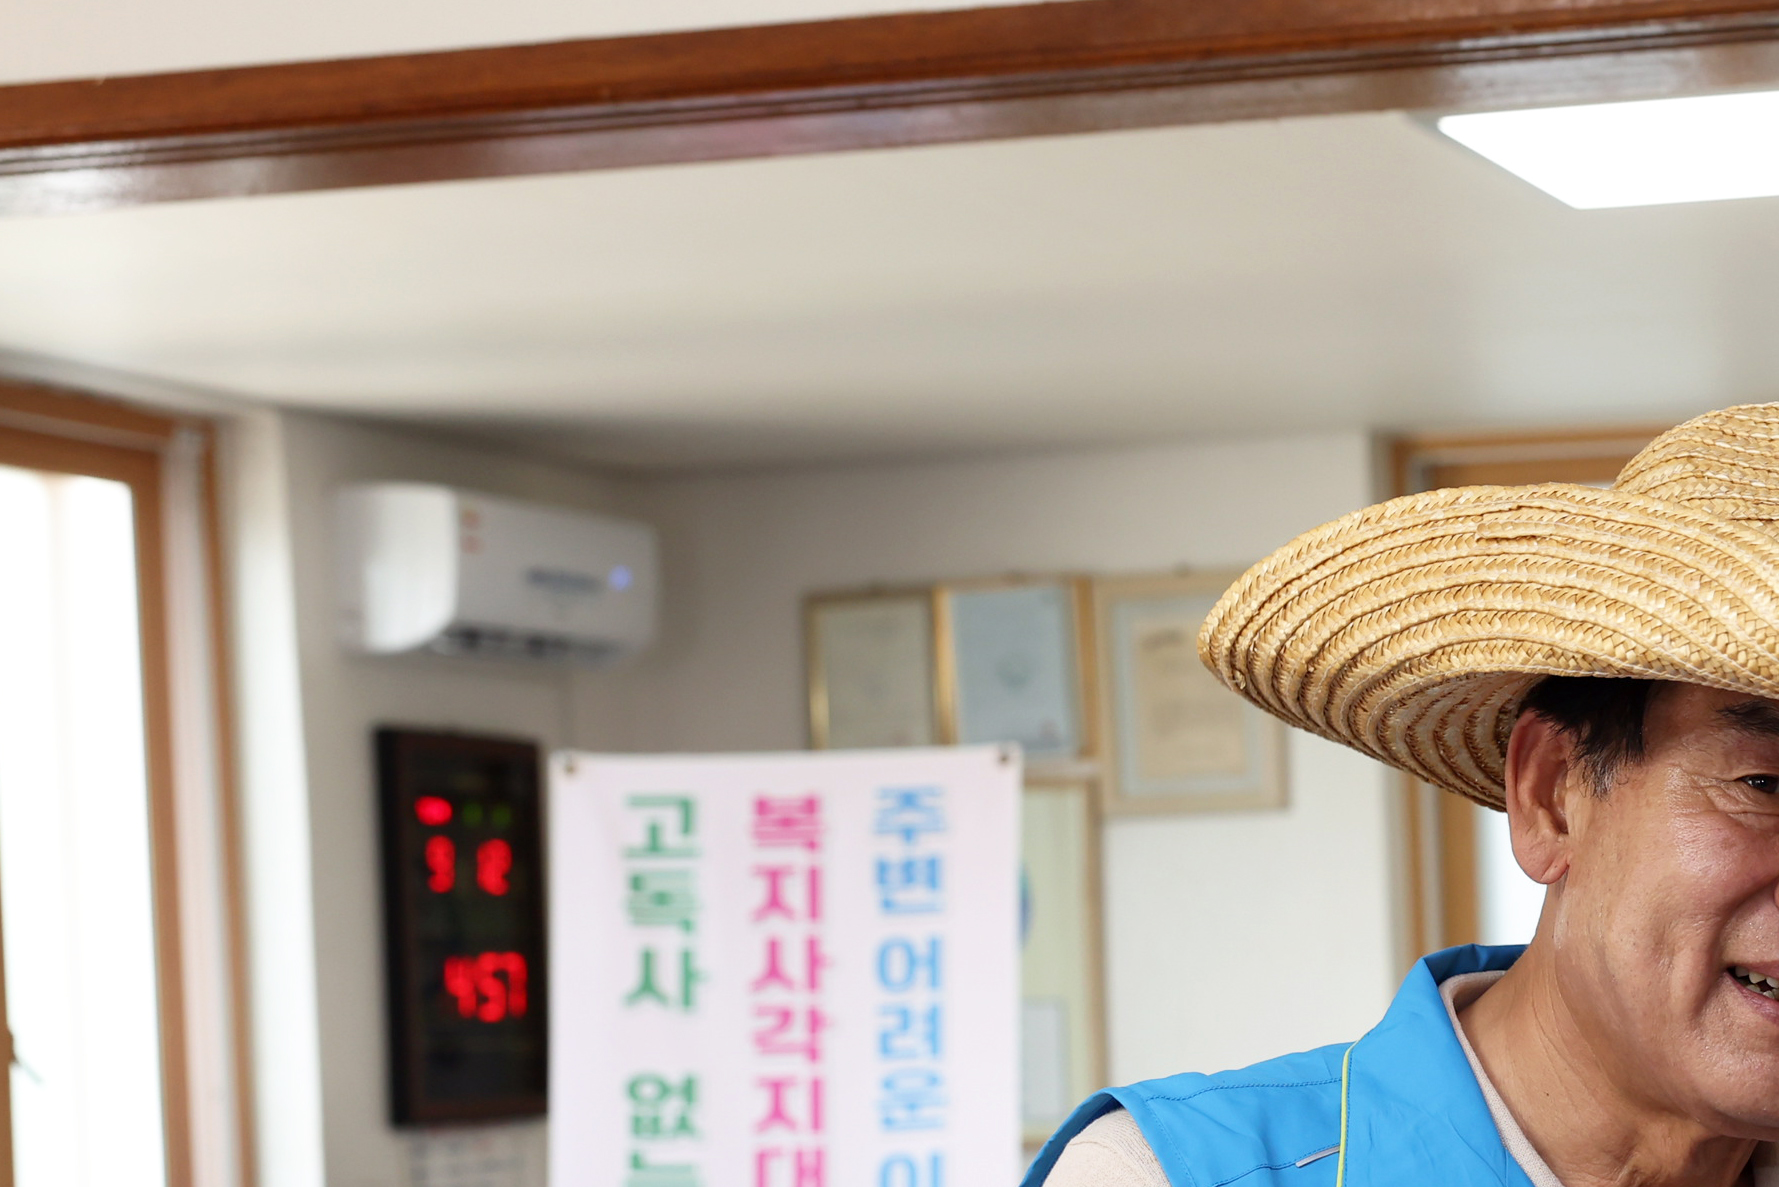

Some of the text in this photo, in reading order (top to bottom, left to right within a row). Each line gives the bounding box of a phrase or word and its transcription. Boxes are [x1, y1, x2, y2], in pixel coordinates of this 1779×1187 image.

[625, 794, 706, 1011] 고독사
[873, 786, 944, 915] 주변
[876, 935, 944, 1132] 어려운
